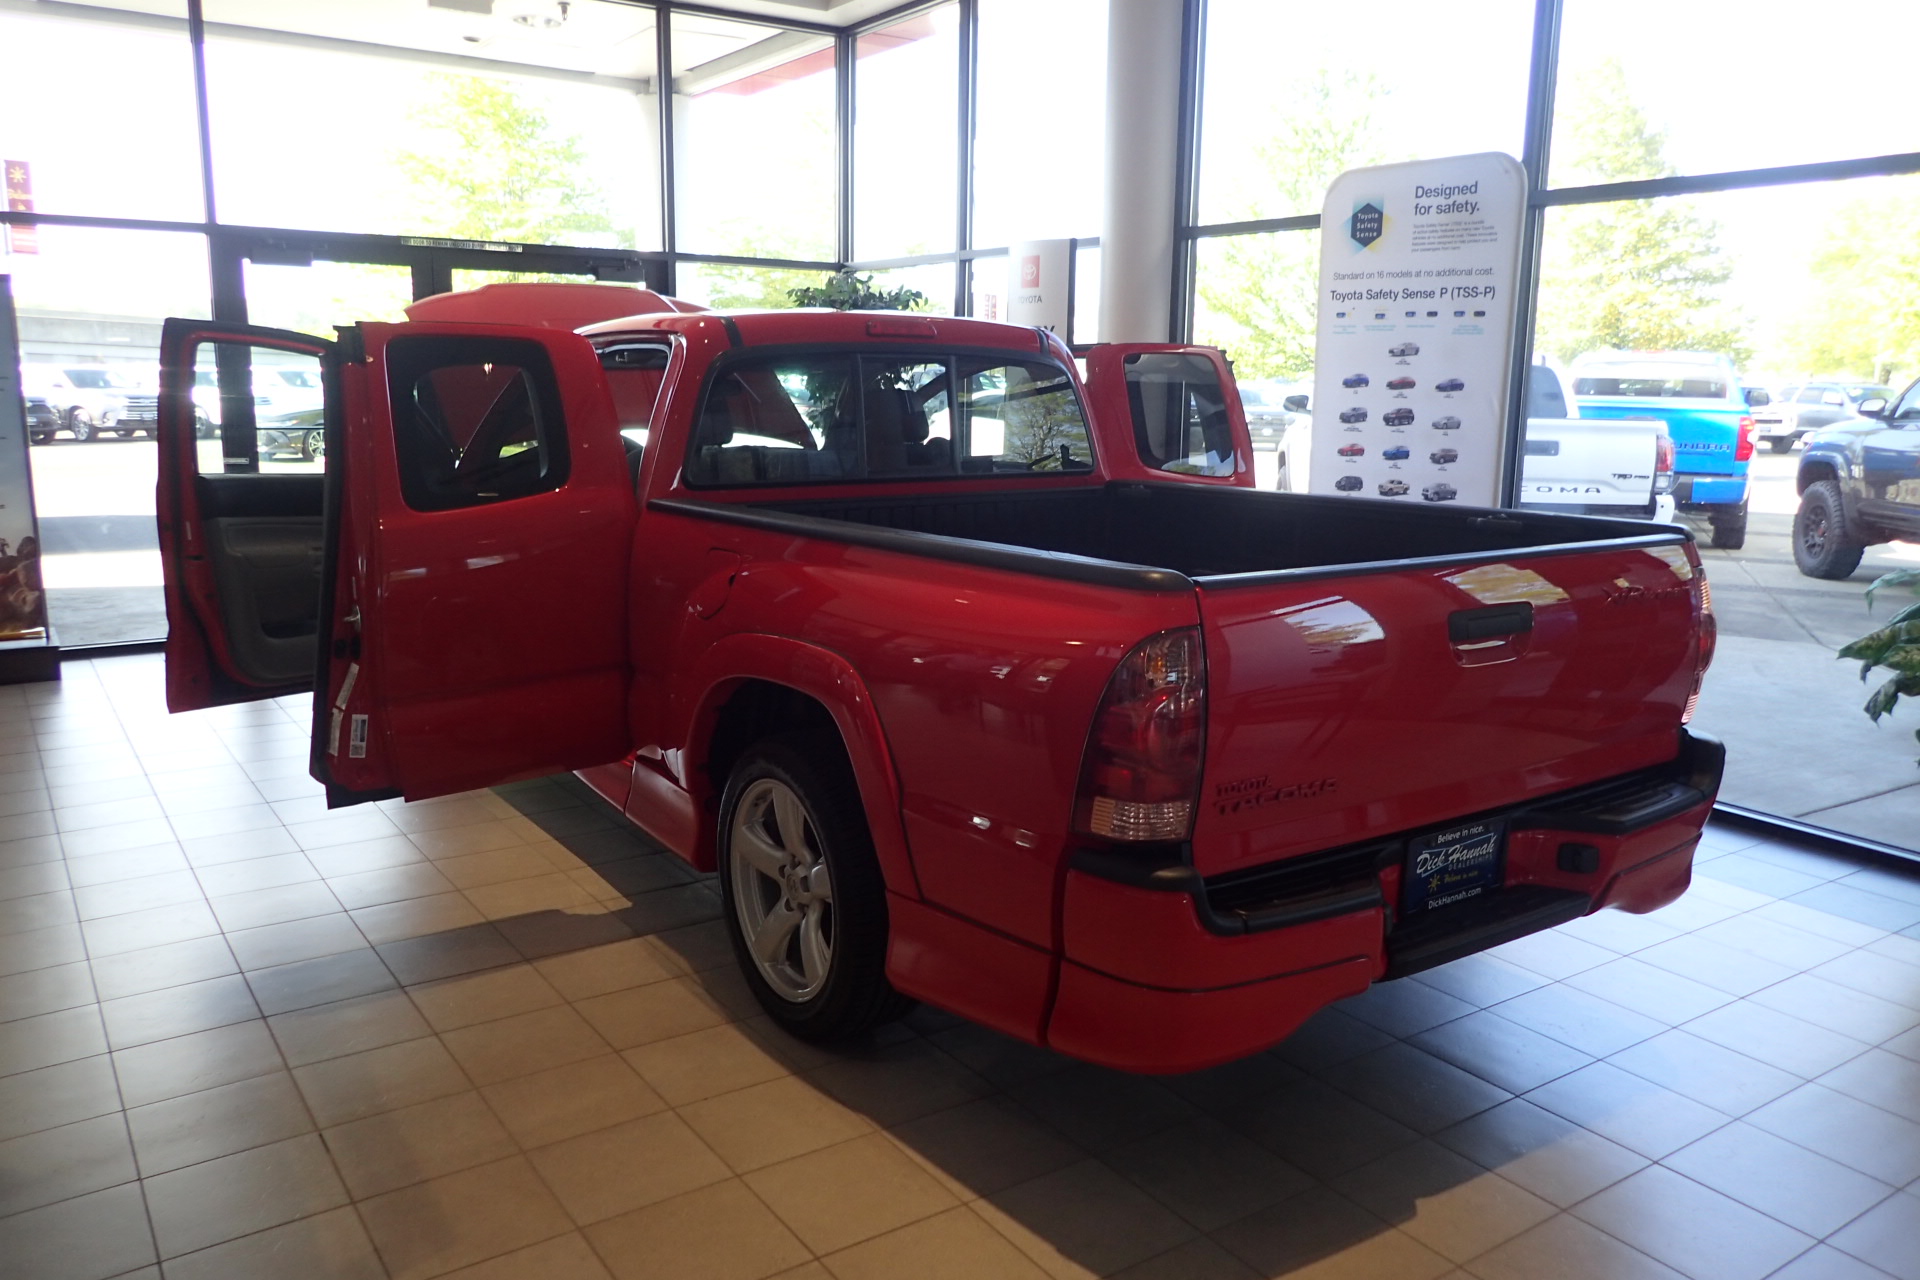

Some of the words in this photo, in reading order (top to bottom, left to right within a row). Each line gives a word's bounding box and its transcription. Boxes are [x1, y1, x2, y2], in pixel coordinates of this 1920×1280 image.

[1415, 181, 1478, 199] Designed
[1414, 202, 1432, 215] for
[1436, 200, 1480, 216] safety.
[1357, 212, 1379, 221] Toyota
[1356, 221, 1378, 230] Safety
[1356, 231, 1377, 239] Sense
[1333, 272, 1364, 281] Standard
[1377, 271, 1384, 279] 16
[1385, 270, 1413, 279] models
[1414, 270, 1422, 278] at
[1435, 268, 1473, 277] additional
[1475, 267, 1494, 276] cost.
[1330, 290, 1363, 303] Toyota
[1365, 288, 1399, 302] Safety
[1402, 288, 1435, 300] Sense
[1440, 287, 1448, 299] P
[1451, 286, 1496, 301] (TSS-P)
[1437, 831, 1460, 844] Believe
[1462, 828, 1468, 837] in
[1469, 825, 1484, 835] nice.
[1416, 849, 1446, 874] Dick
[1448, 834, 1497, 863] Hannah
[1428, 887, 1482, 910] DickHannah.com
